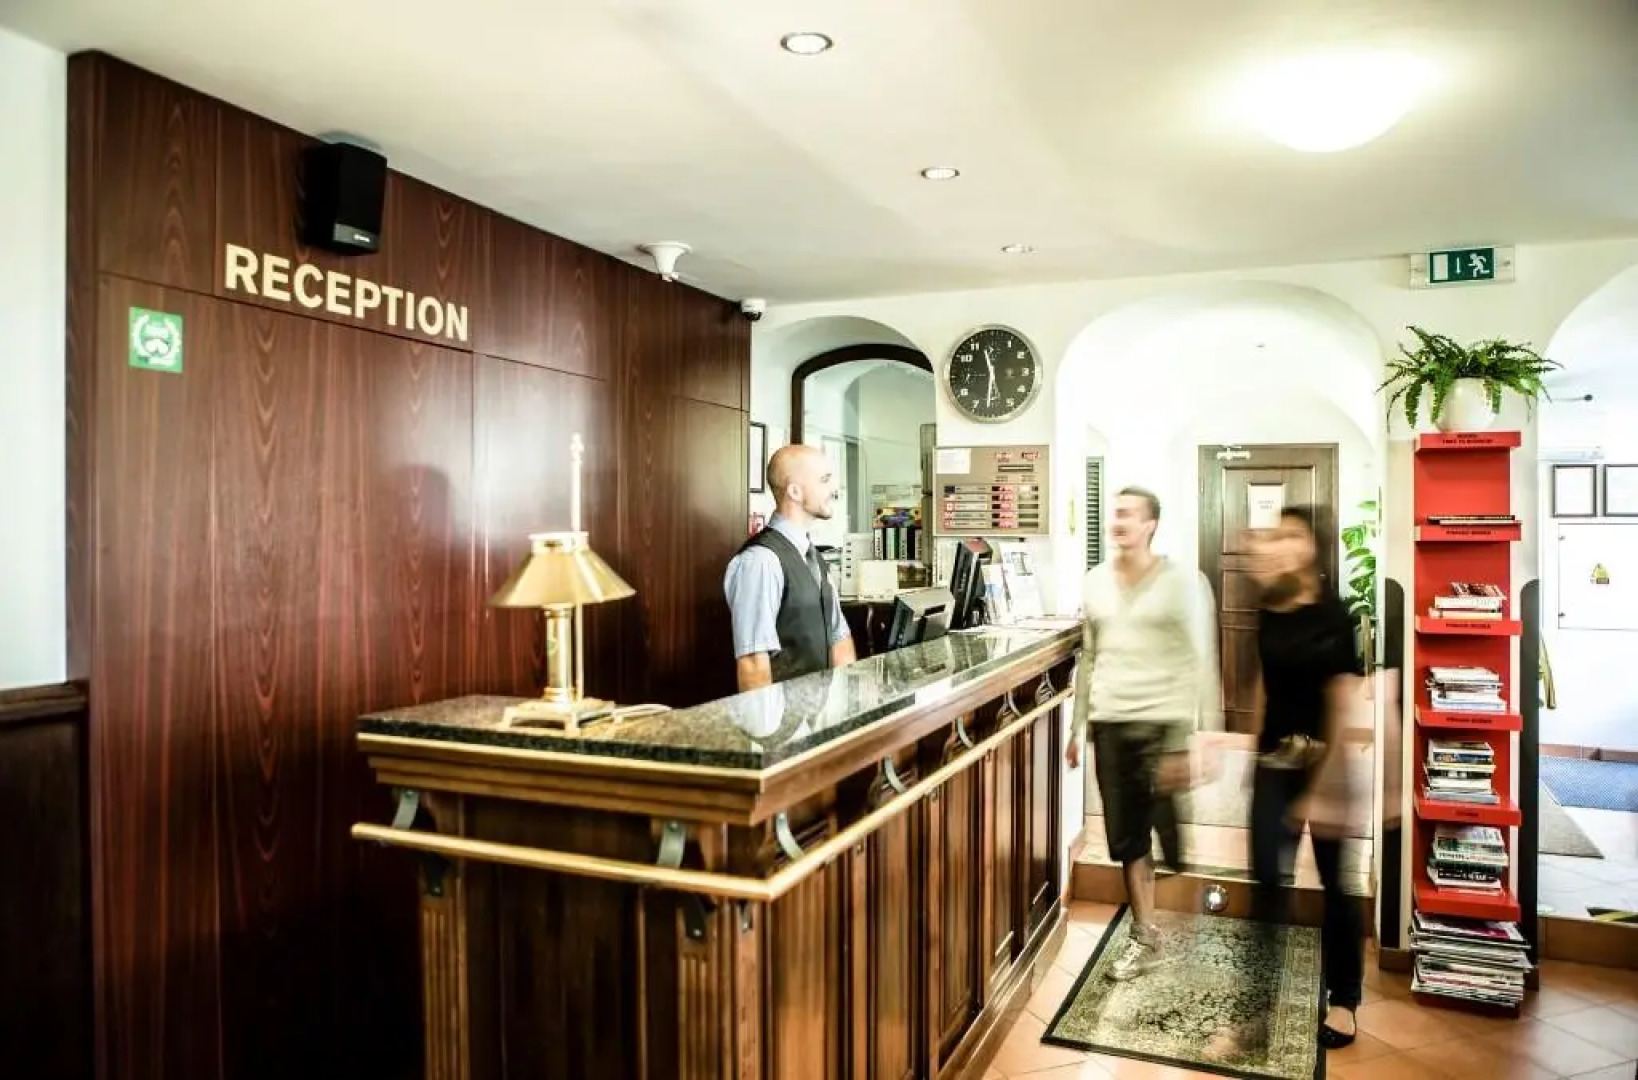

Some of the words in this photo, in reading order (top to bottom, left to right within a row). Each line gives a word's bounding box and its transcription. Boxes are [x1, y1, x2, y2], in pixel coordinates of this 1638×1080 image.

[224, 243, 468, 342] RECEPTION
[970, 342, 980, 351] 11
[960, 354, 973, 363] 10
[1016, 351, 1026, 359] 2
[1021, 367, 1030, 377] 3
[1016, 384, 1026, 393] 4
[971, 399, 980, 409] 7
[1006, 397, 1015, 407] 5
